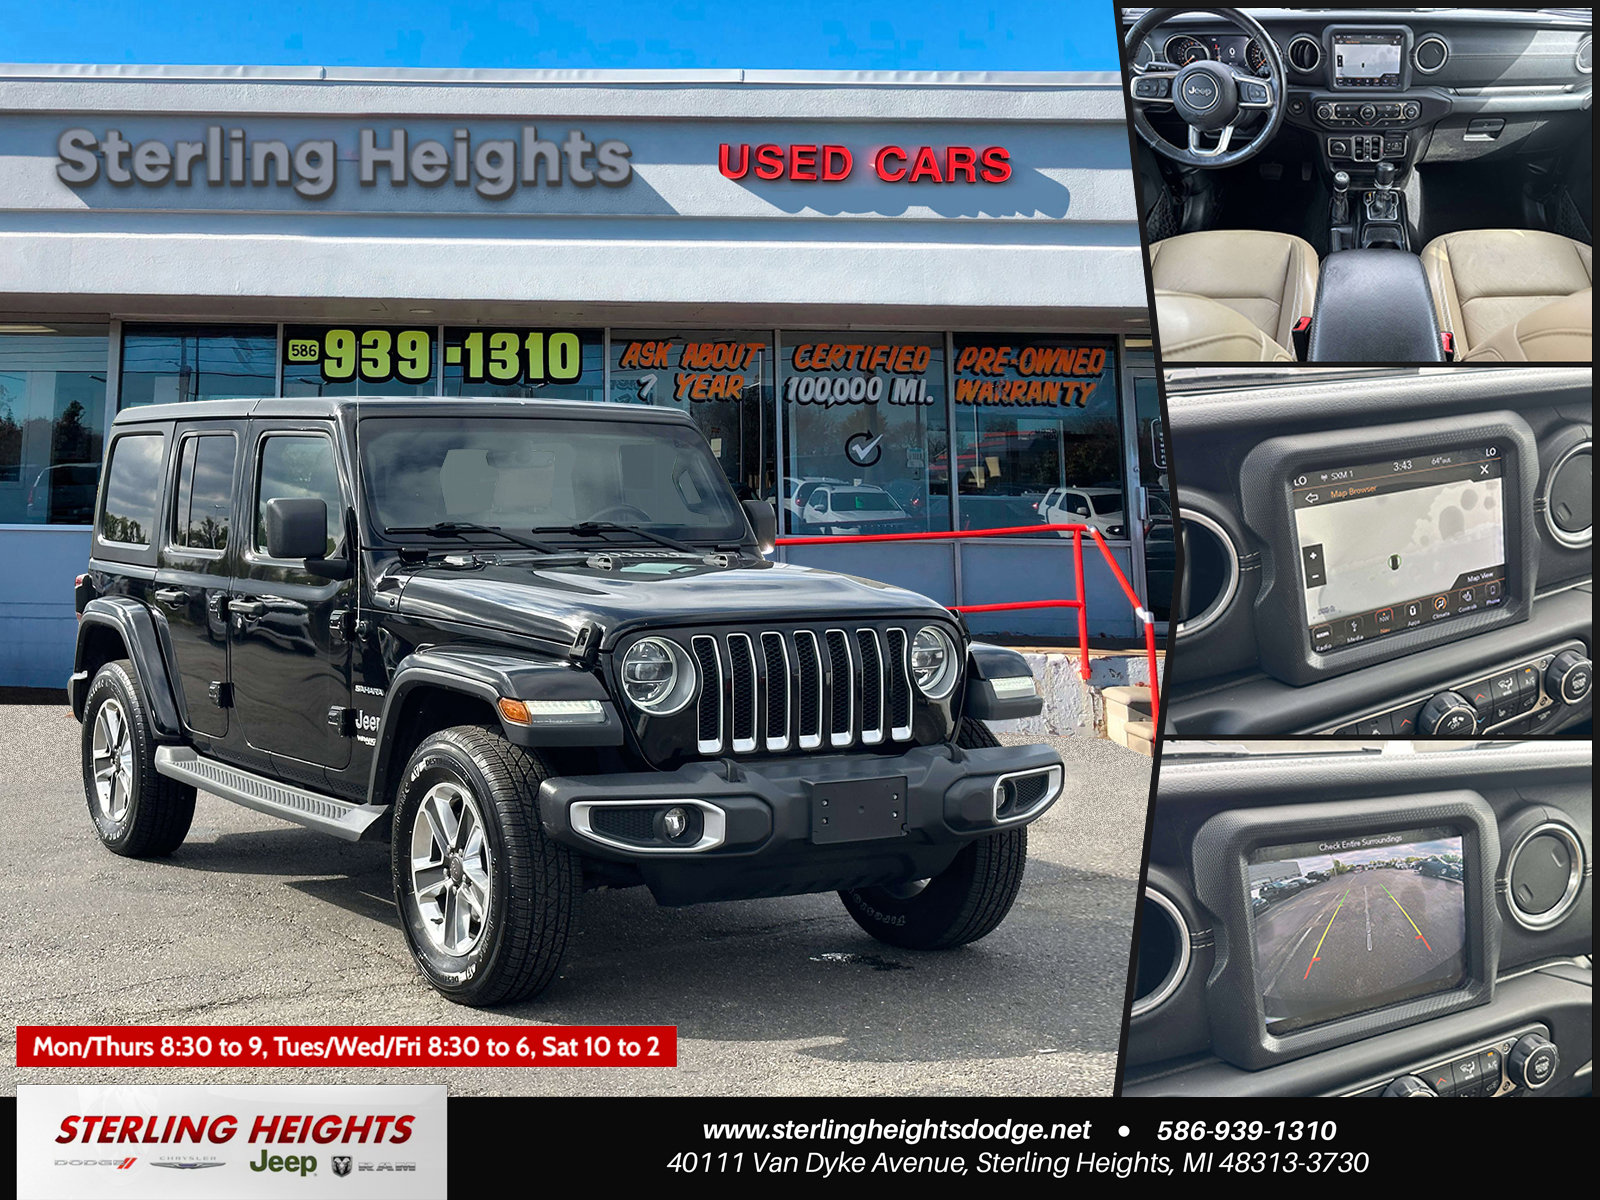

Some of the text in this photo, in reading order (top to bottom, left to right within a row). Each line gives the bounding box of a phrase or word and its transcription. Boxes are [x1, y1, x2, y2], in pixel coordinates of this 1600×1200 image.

[1188, 86, 1212, 97] Jeep
[56, 126, 633, 200] Sterling Heights
[718, 143, 1013, 183] USED CARS
[290, 342, 318, 359] 586
[322, 328, 430, 382] 939
[619, 342, 766, 373] ASK ABOUT
[792, 343, 931, 375] CERTIFIED
[954, 346, 1106, 378] PRE-OWNED
[637, 373, 745, 402] 1 YEAR
[784, 376, 934, 409] 100,000 MI.
[954, 378, 1097, 408] WARRANTY
[1293, 475, 1308, 487] LO
[1330, 471, 1347, 481] SXM
[1392, 459, 1413, 472] 3:43
[1485, 447, 1497, 457] LO
[1330, 485, 1377, 499] Map Browser
[1467, 571, 1494, 583] Map View
[354, 684, 385, 697] SAHARA
[1318, 835, 1403, 852] Check Entire Surroundings
